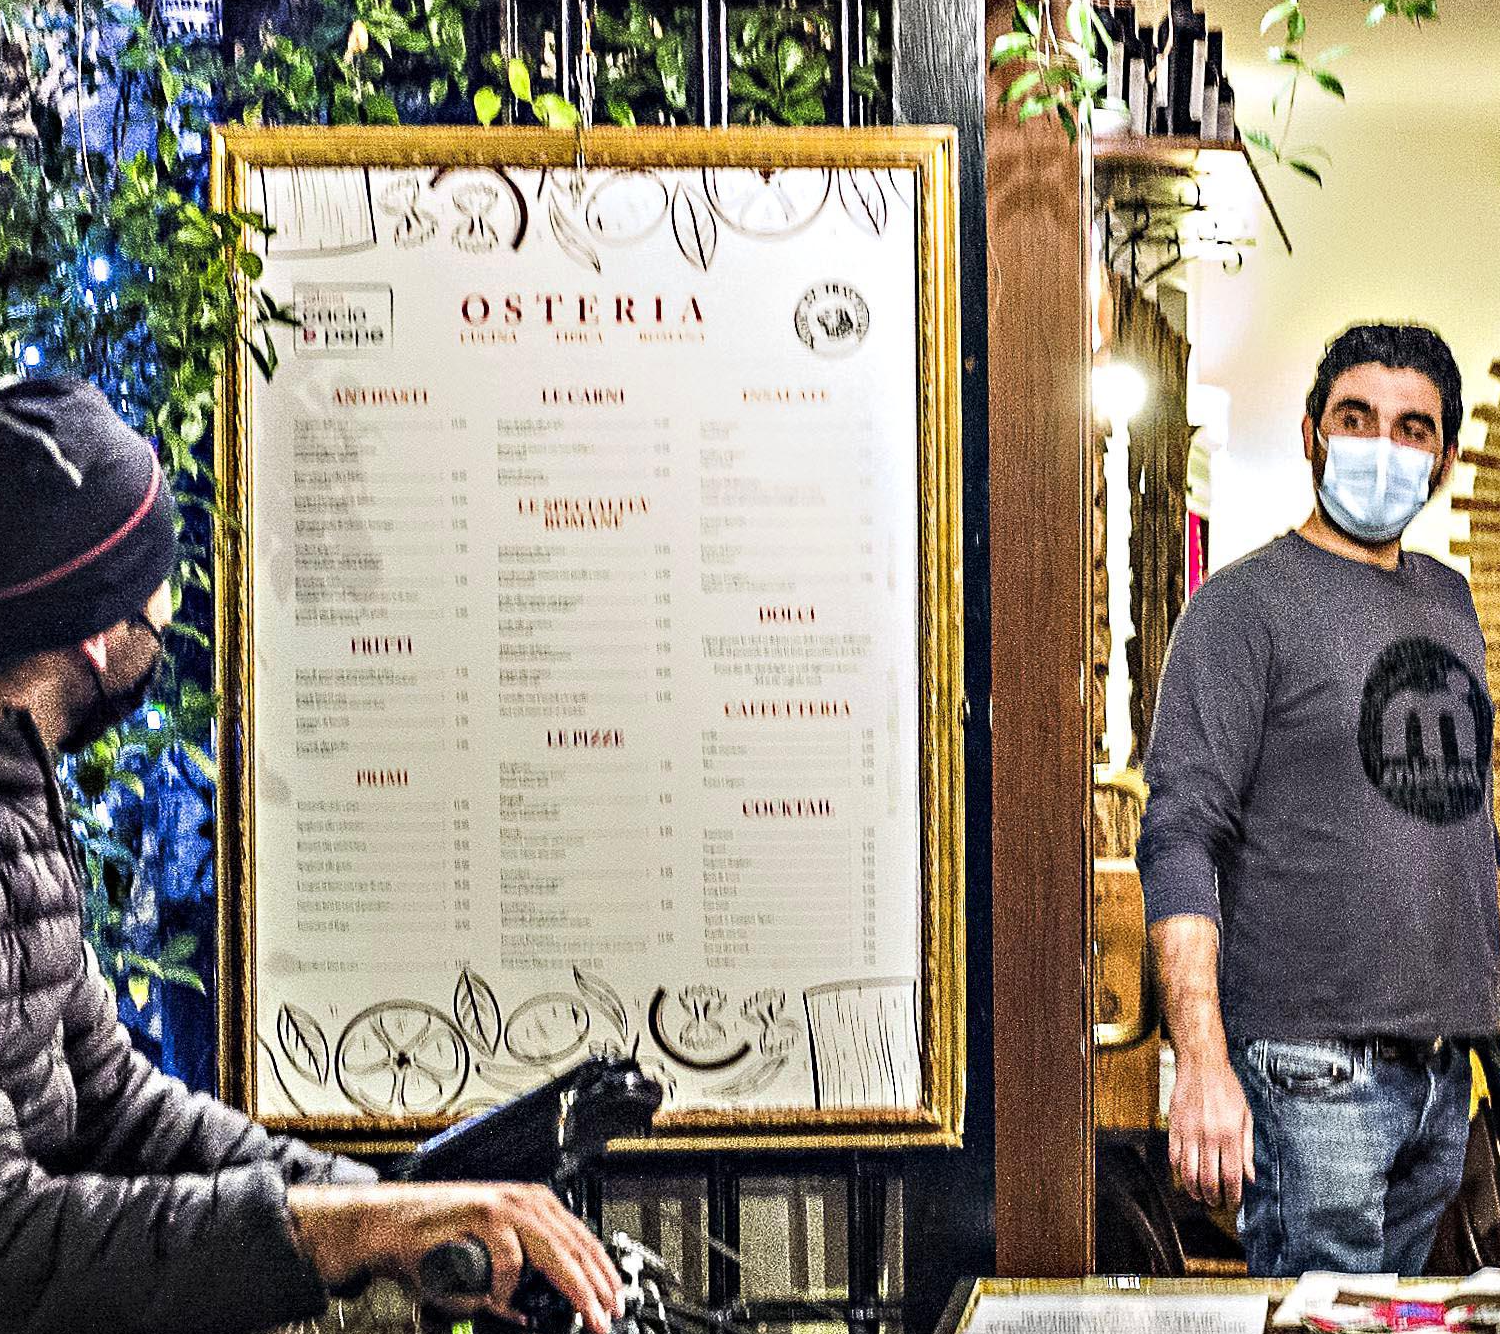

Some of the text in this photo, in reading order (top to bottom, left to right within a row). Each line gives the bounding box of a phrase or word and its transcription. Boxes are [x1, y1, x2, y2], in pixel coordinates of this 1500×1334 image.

[461, 292, 704, 327] OSTERIA
[566, 387, 624, 405] CARNI
[543, 513, 623, 530] ROMANE
[758, 605, 816, 625] DOLCI
[723, 699, 851, 717] CAFFETTERIA
[547, 729, 625, 748] LE PIZZE
[357, 769, 409, 787] PRIMI
[741, 798, 835, 818] COCKTAIL
